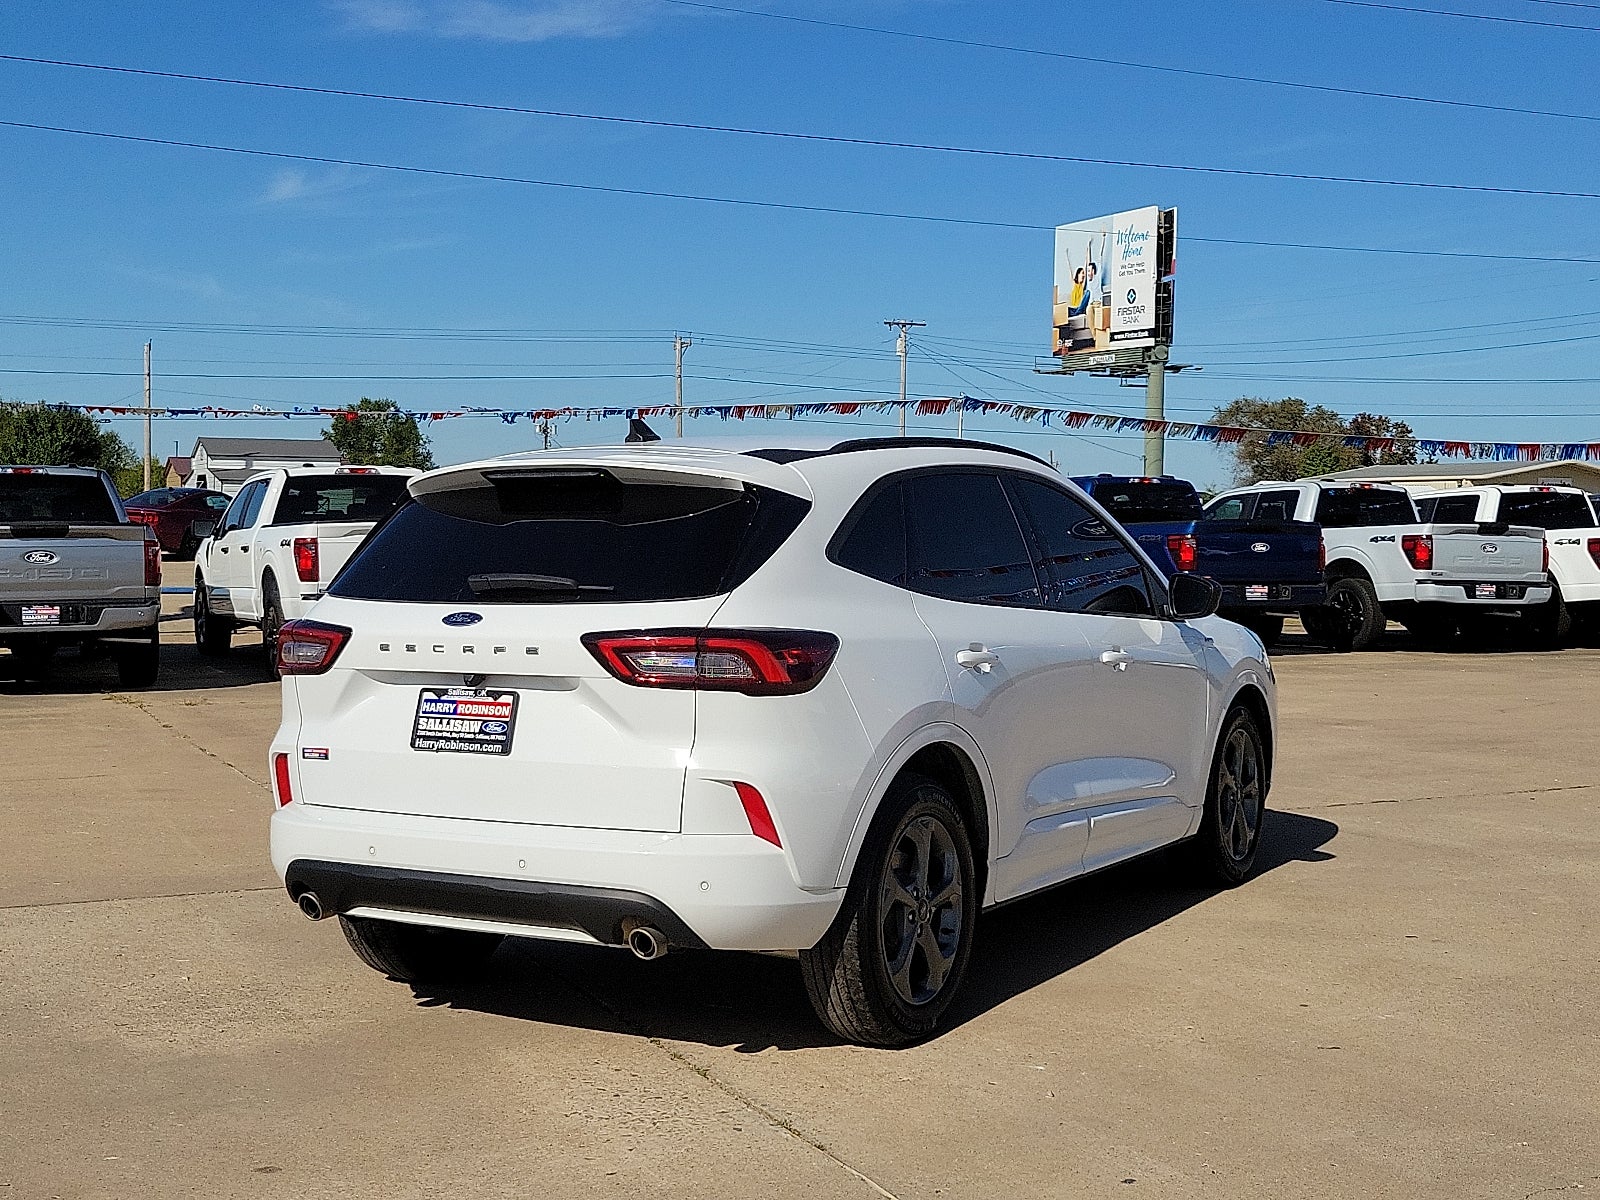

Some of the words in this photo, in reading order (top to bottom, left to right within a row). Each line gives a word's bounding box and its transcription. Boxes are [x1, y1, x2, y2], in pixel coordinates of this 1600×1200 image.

[1117, 223, 1149, 245] Welcome
[1122, 243, 1143, 261] Home
[1117, 305, 1146, 316] FIRSTAR
[1122, 315, 1140, 325] BANK
[29, 552, 51, 563] Ford
[379, 643, 540, 655] ESCAPE
[476, 689, 488, 697] OK
[422, 701, 457, 713] HARRY
[457, 703, 512, 716] ROBINSON
[418, 718, 483, 733] SALLISAW
[415, 738, 502, 753] HarryRobinson.com
